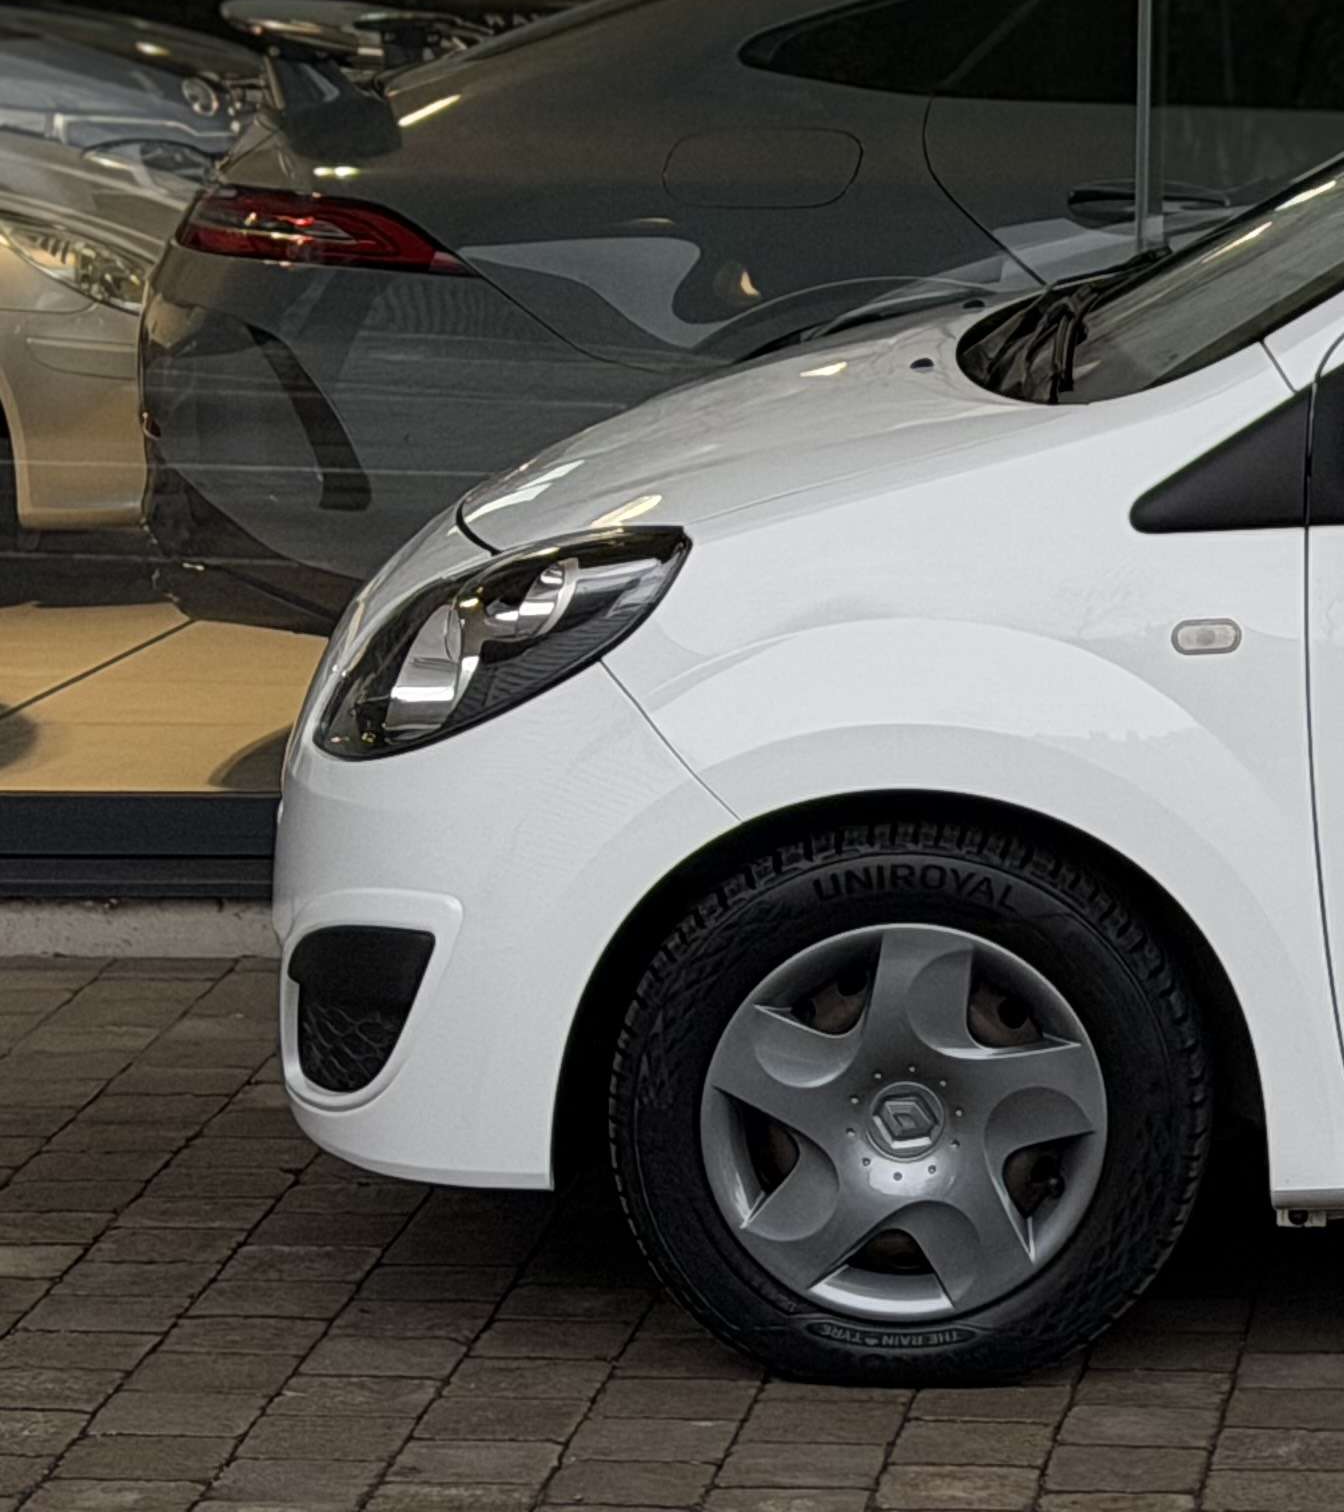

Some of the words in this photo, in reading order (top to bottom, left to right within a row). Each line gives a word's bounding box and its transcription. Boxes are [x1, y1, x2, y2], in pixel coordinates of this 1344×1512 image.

[811, 863, 1017, 913] UNIROYAL
[821, 1324, 862, 1344] TYRE
[881, 1334, 923, 1347] RAIN
[928, 1330, 957, 1344] THE
